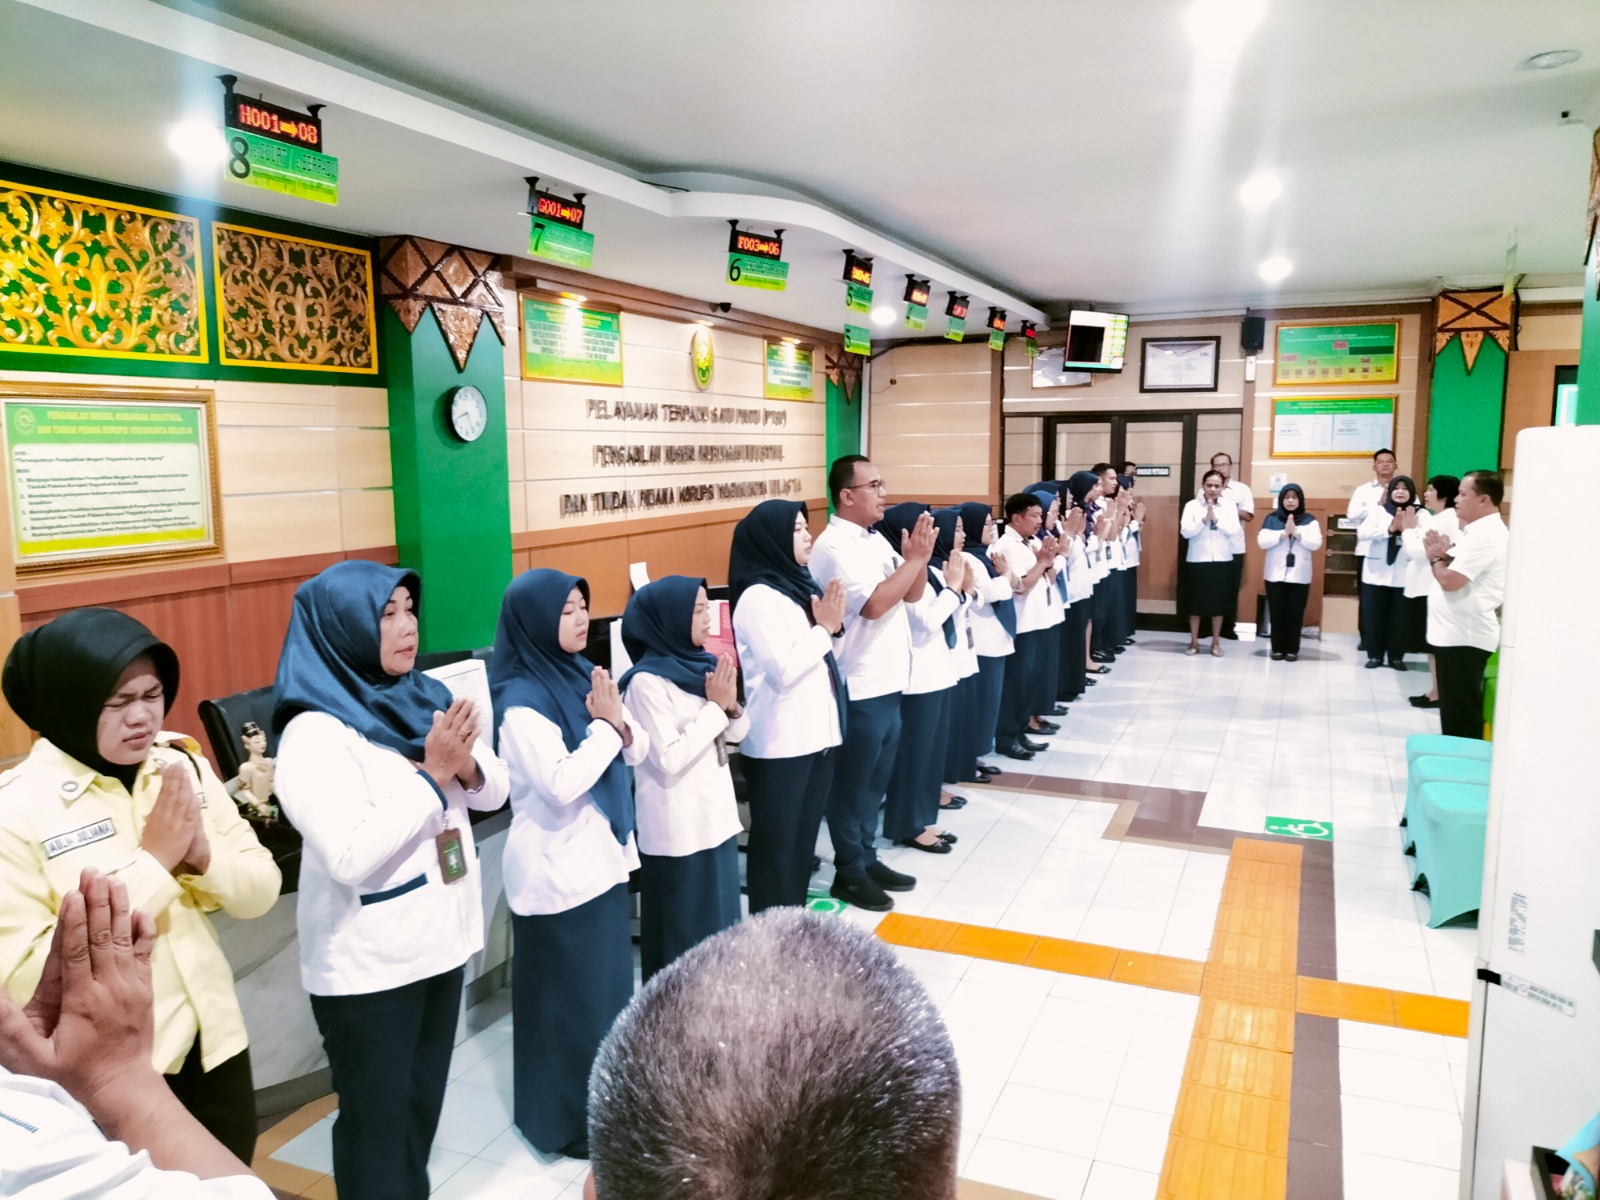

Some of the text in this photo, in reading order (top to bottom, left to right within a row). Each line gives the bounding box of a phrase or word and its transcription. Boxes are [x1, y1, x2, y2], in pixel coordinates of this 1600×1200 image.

[239, 103, 281, 134] H001
[229, 136, 251, 179] 8
[533, 221, 546, 252] 7
[729, 258, 742, 282] 6
[585, 398, 658, 422] PELAYANAN
